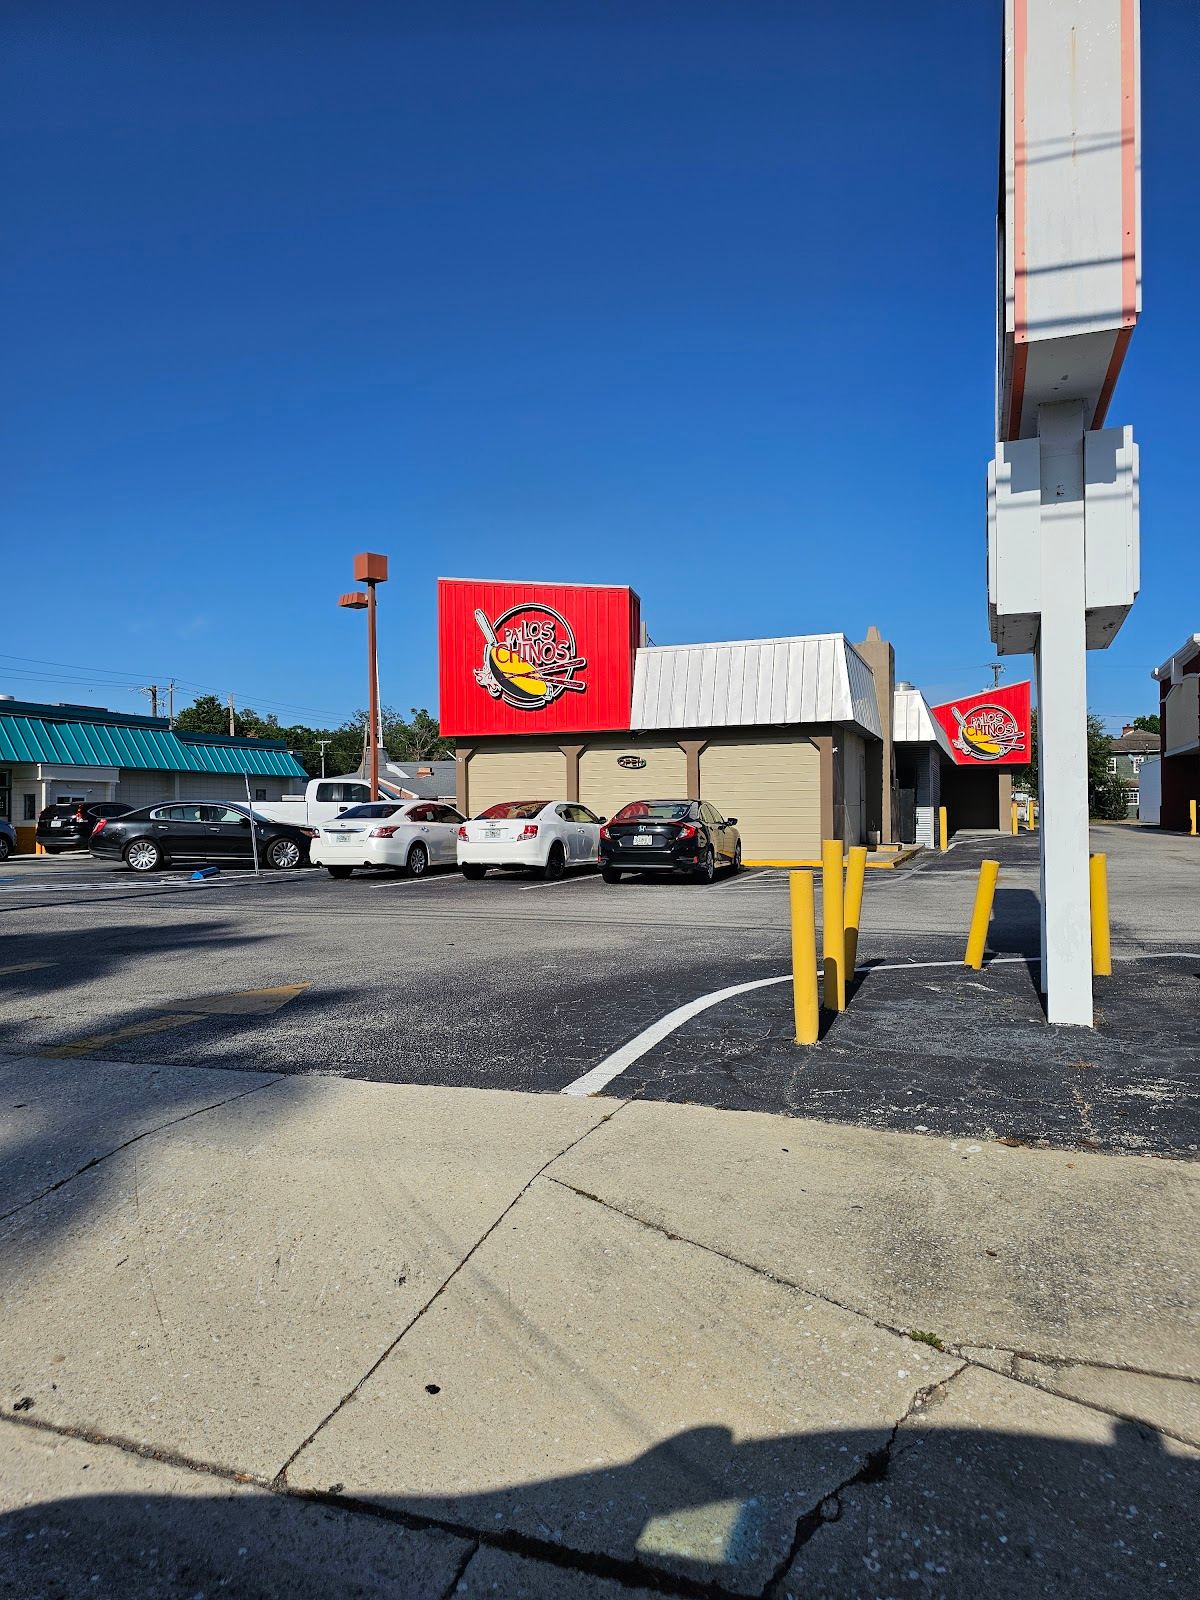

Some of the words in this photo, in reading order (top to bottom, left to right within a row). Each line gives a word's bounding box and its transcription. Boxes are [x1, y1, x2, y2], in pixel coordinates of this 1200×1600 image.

[521, 620, 555, 641] LOS
[495, 640, 570, 663] CHINOS
[982, 712, 1004, 724] LOS
[966, 722, 1014, 736] CHINOS
